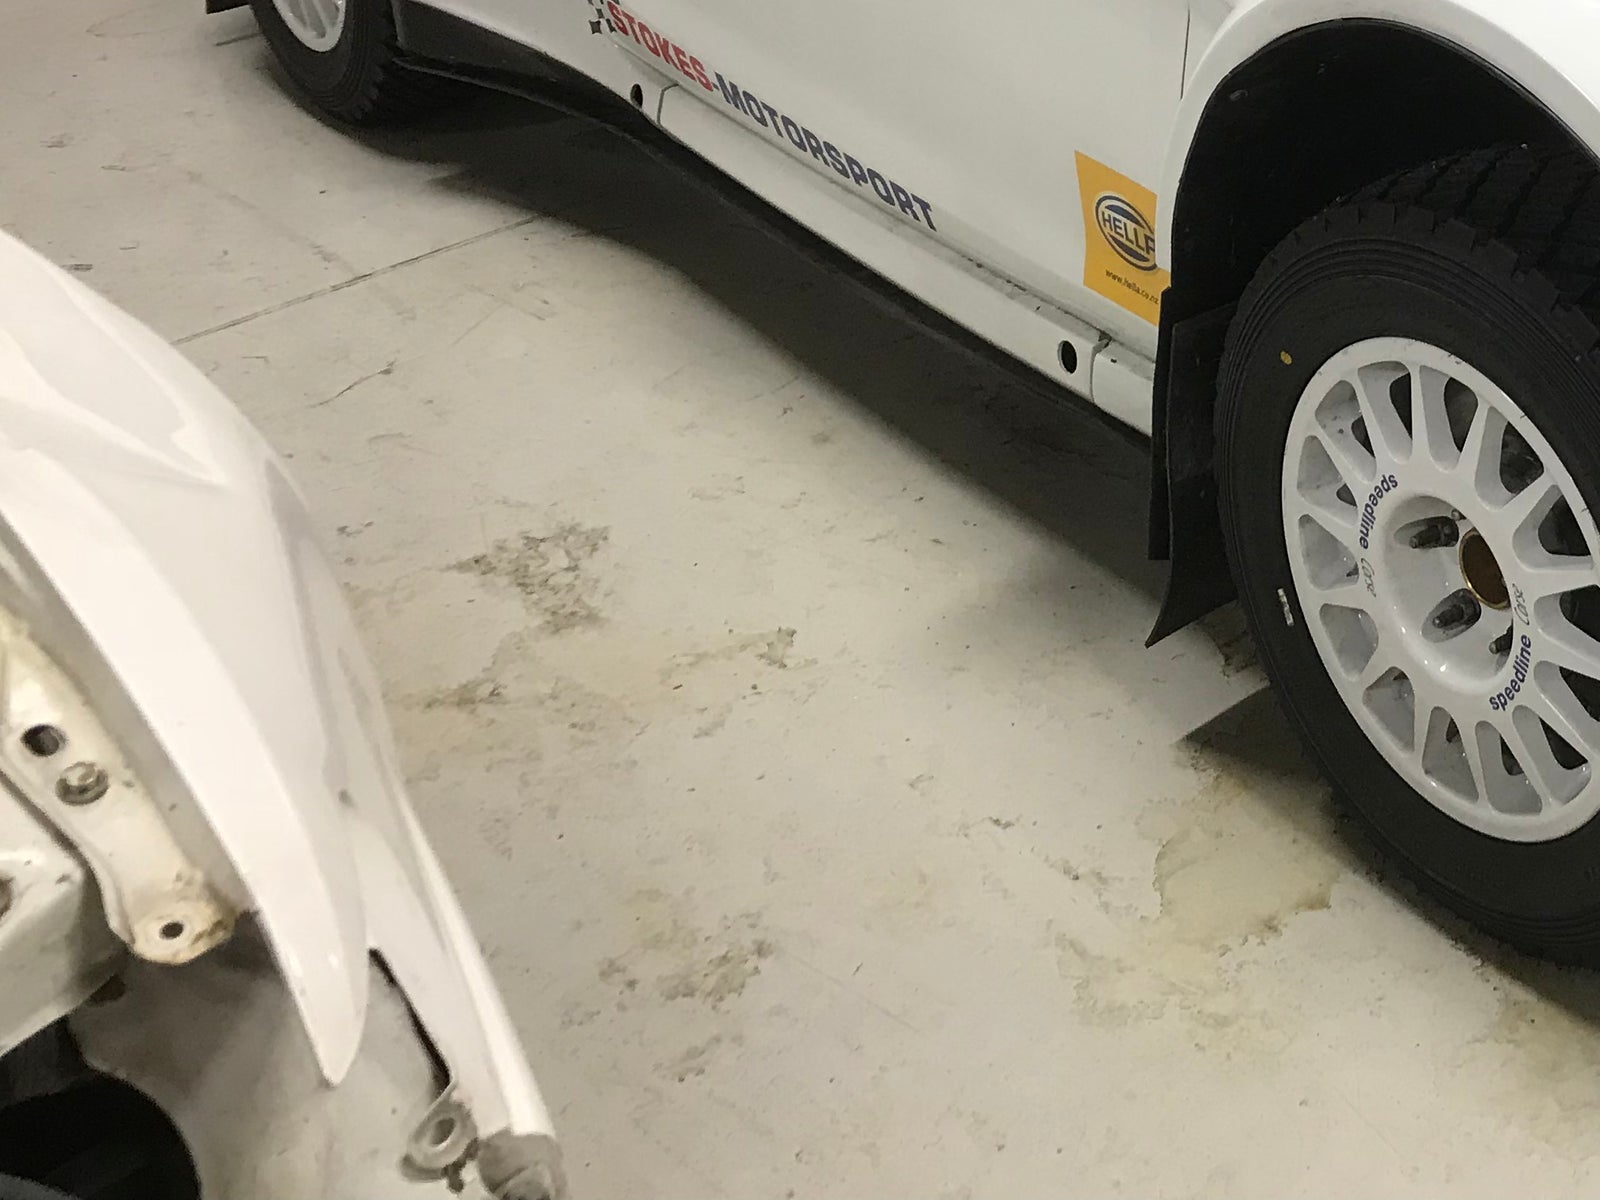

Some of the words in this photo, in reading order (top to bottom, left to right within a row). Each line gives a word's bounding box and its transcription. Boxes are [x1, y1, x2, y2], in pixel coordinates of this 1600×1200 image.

[606, 0, 938, 232] STOKES-MOTORSPORT
[1359, 474, 1399, 550] speedline
[1488, 634, 1532, 711] speedline
